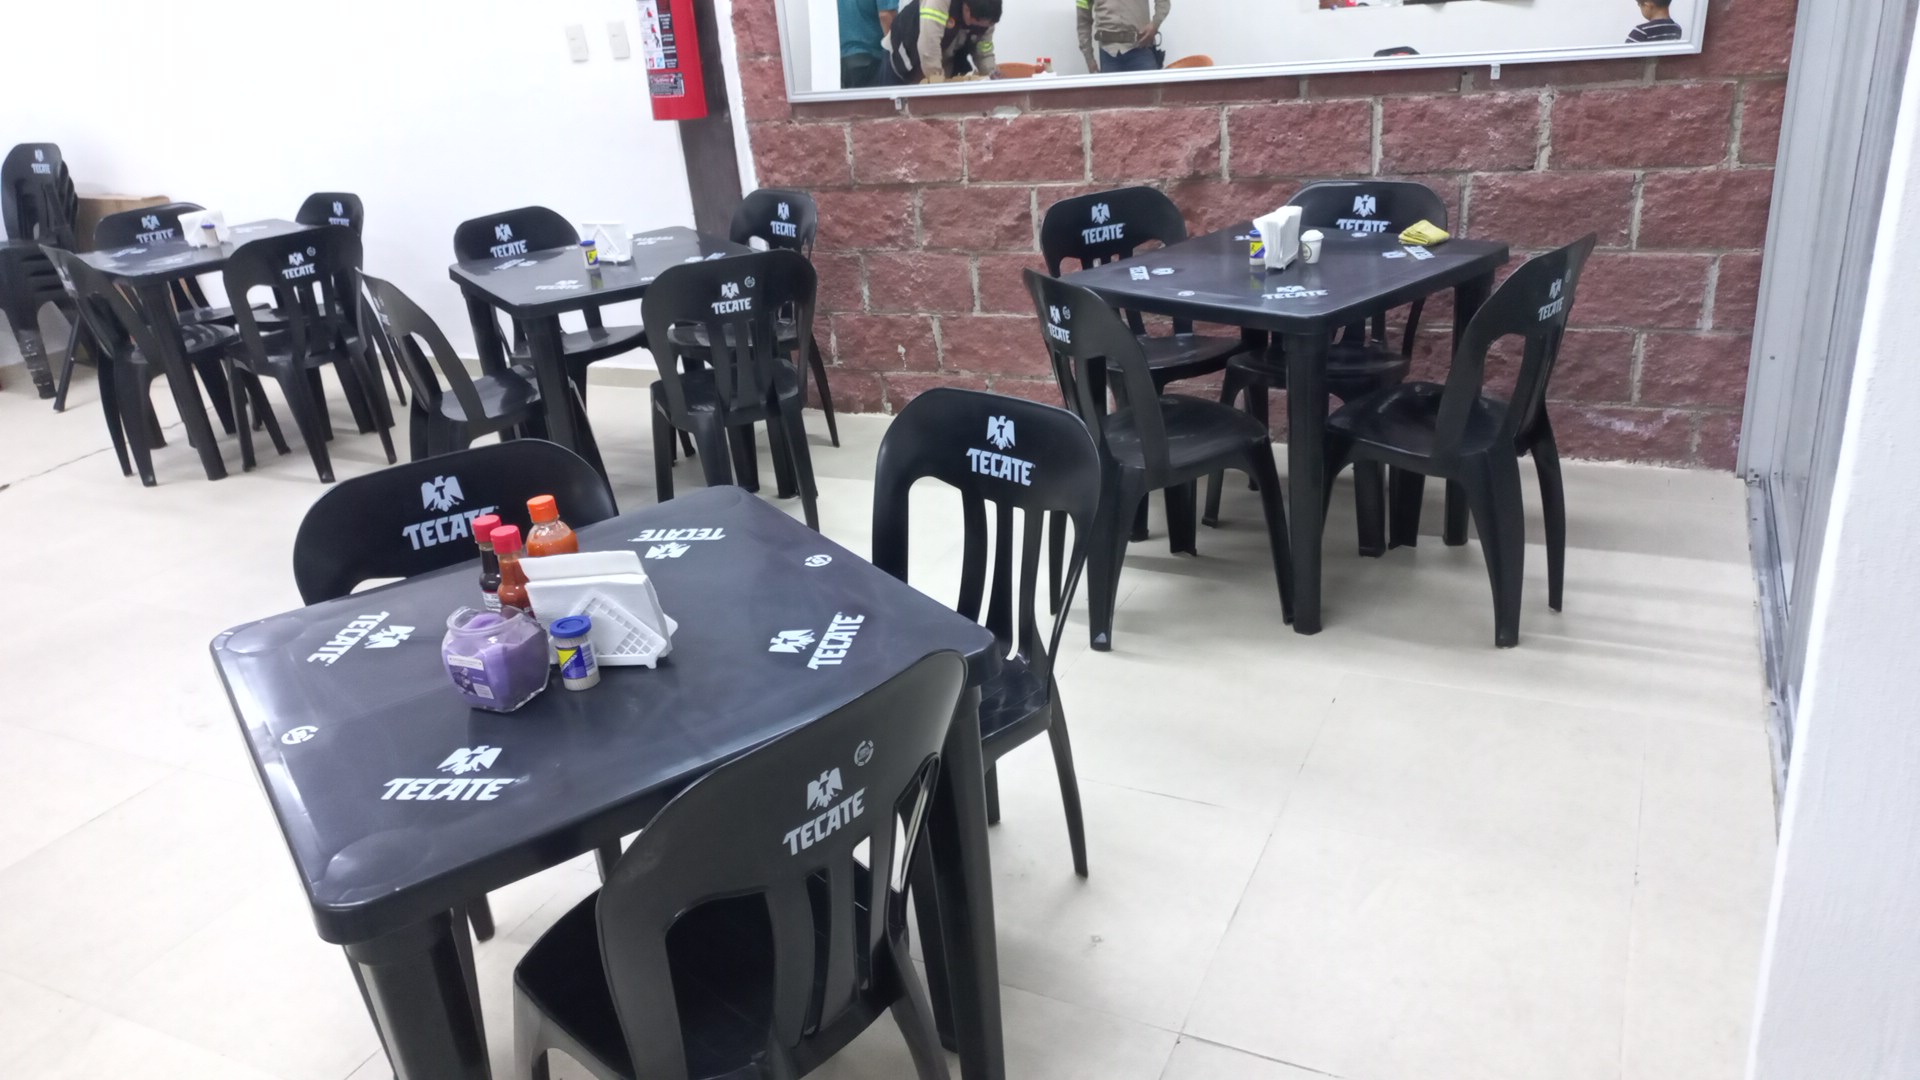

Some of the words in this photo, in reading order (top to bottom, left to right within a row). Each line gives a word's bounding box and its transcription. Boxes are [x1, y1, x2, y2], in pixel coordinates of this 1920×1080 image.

[771, 220, 796, 238] TECATE
[1081, 222, 1126, 246] TECATE
[1335, 218, 1392, 234] TECATE
[490, 239, 529, 258] TECATE
[282, 263, 316, 280] TECATE
[711, 297, 752, 315] TECATE
[1538, 296, 1564, 322] TECATE
[1047, 322, 1071, 344] TECATE
[966, 447, 1034, 486] TECATE
[634, 527, 726, 542] TECATE
[307, 611, 390, 667] TECATE
[807, 612, 865, 670] TECATE
[380, 778, 515, 801] TECATE
[783, 786, 868, 856] TECATE
